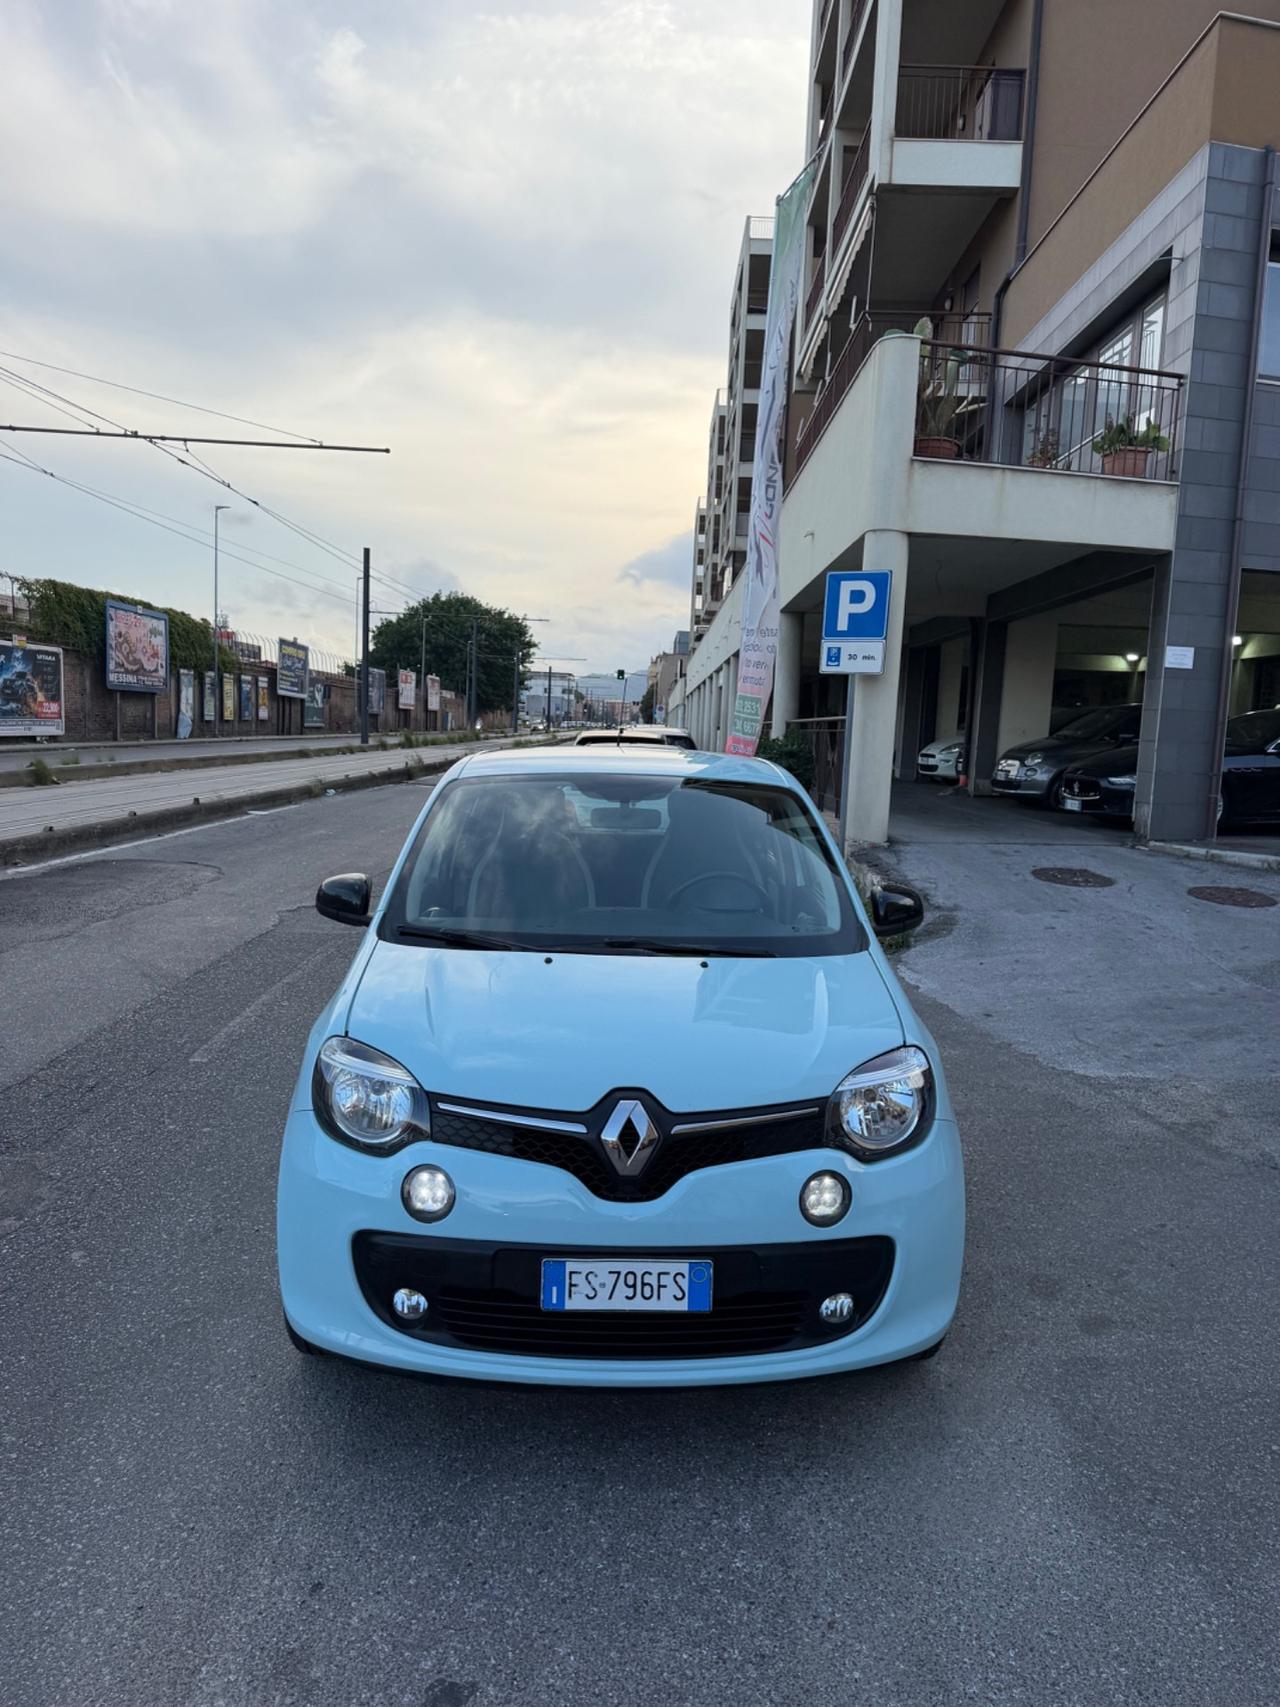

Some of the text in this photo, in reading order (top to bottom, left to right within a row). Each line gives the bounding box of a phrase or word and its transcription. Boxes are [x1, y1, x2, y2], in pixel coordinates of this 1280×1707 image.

[837, 580, 876, 631] P
[847, 653, 858, 661] 30
[109, 672, 137, 684] MESSINA
